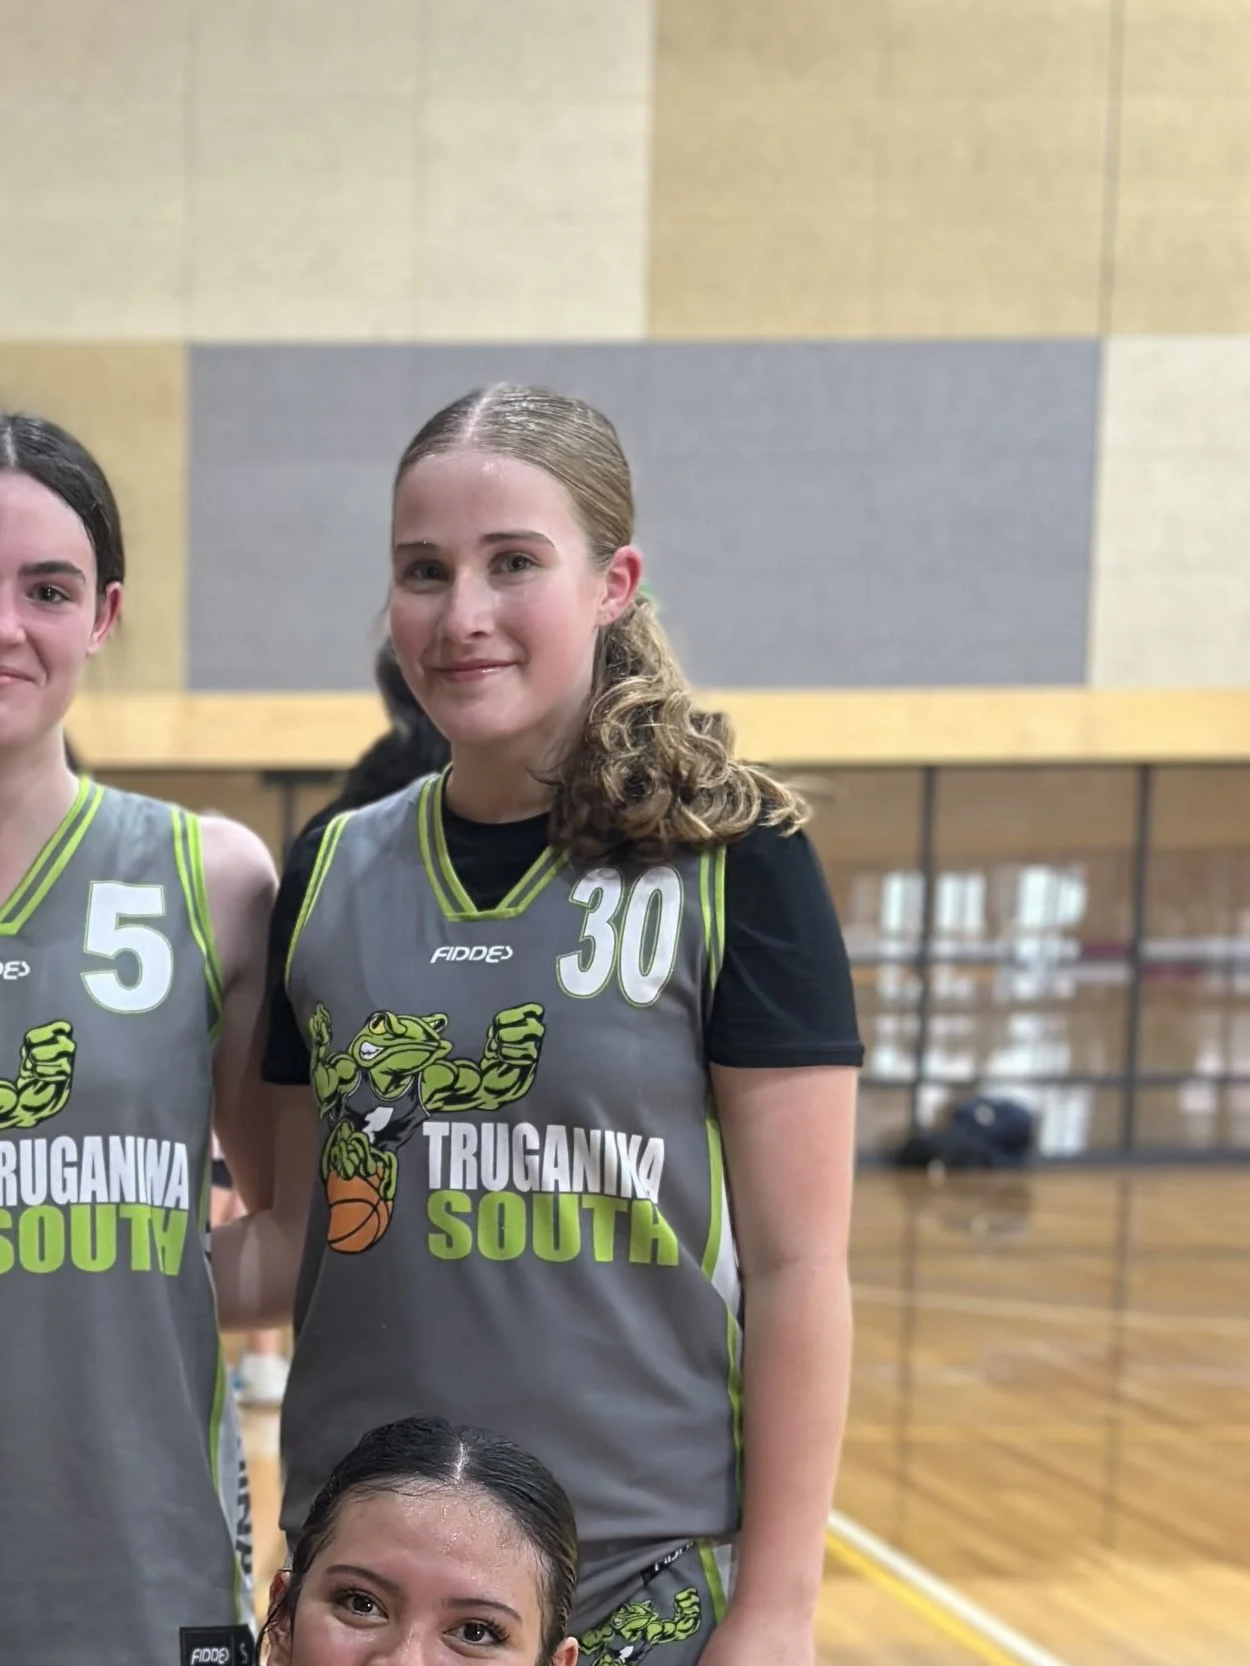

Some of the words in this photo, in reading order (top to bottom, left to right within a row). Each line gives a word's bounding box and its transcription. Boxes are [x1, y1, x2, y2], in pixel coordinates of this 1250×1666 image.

[81, 880, 173, 1014] 5
[556, 865, 683, 1006] 30
[427, 1190, 679, 1266] SOUTH
